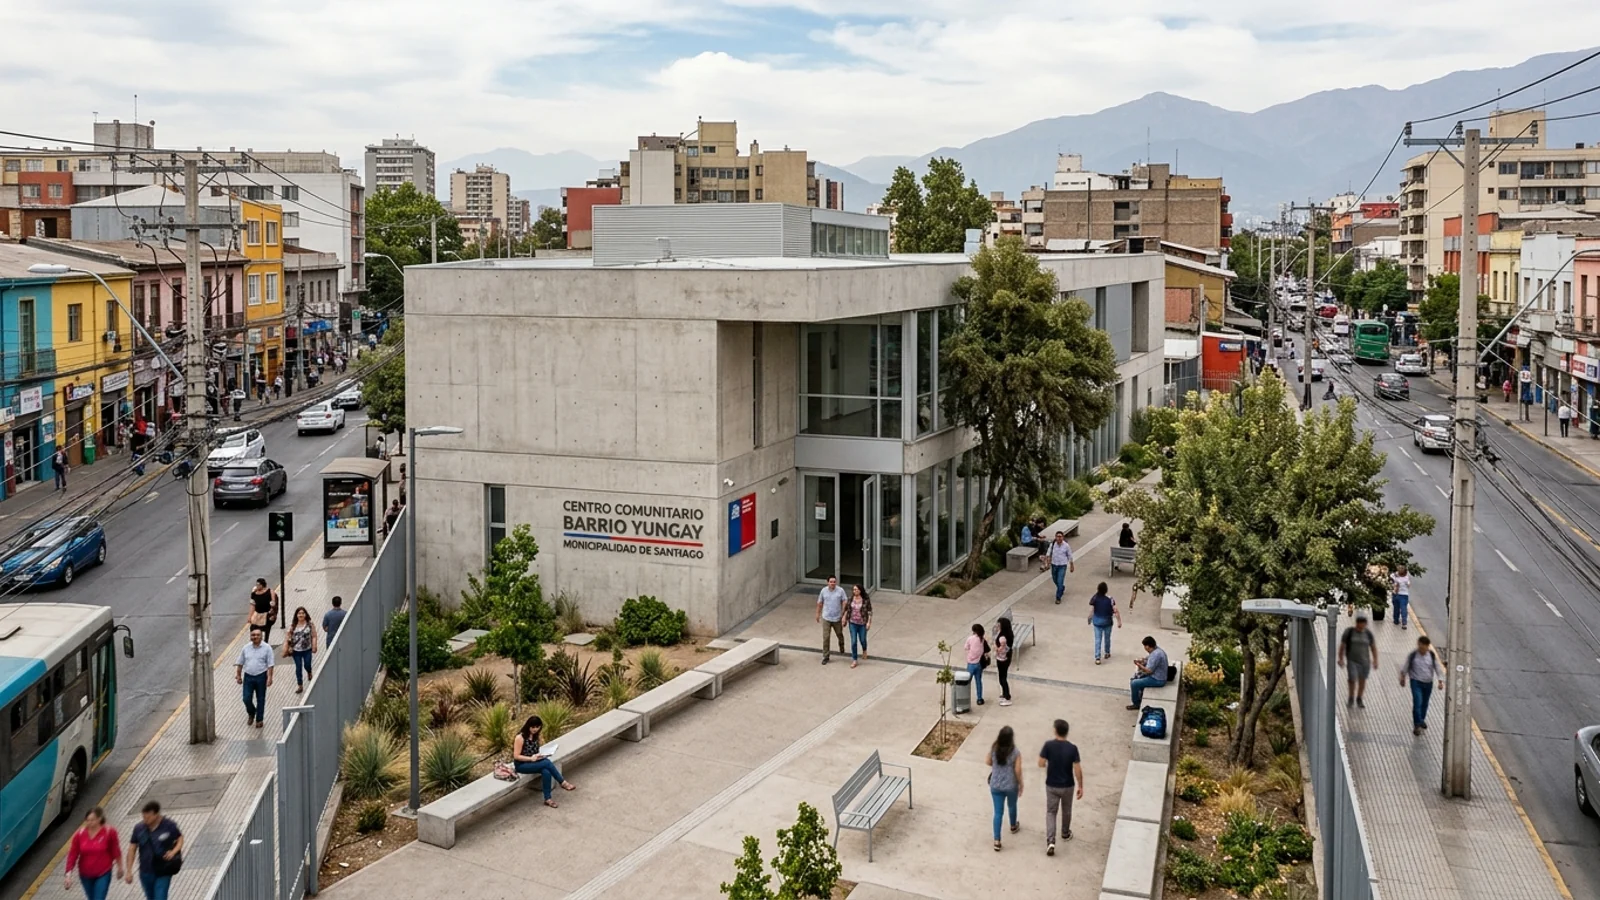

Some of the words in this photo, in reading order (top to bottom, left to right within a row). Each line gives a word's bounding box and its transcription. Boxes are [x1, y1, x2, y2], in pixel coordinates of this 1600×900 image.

[563, 500, 611, 514] CENTRO
[614, 503, 704, 520] COMUNITARIO
[563, 515, 627, 534] BARRIO
[631, 520, 704, 540] YUNGAY
[639, 545, 651, 555] DE
[654, 546, 704, 559] SANTIAGO
